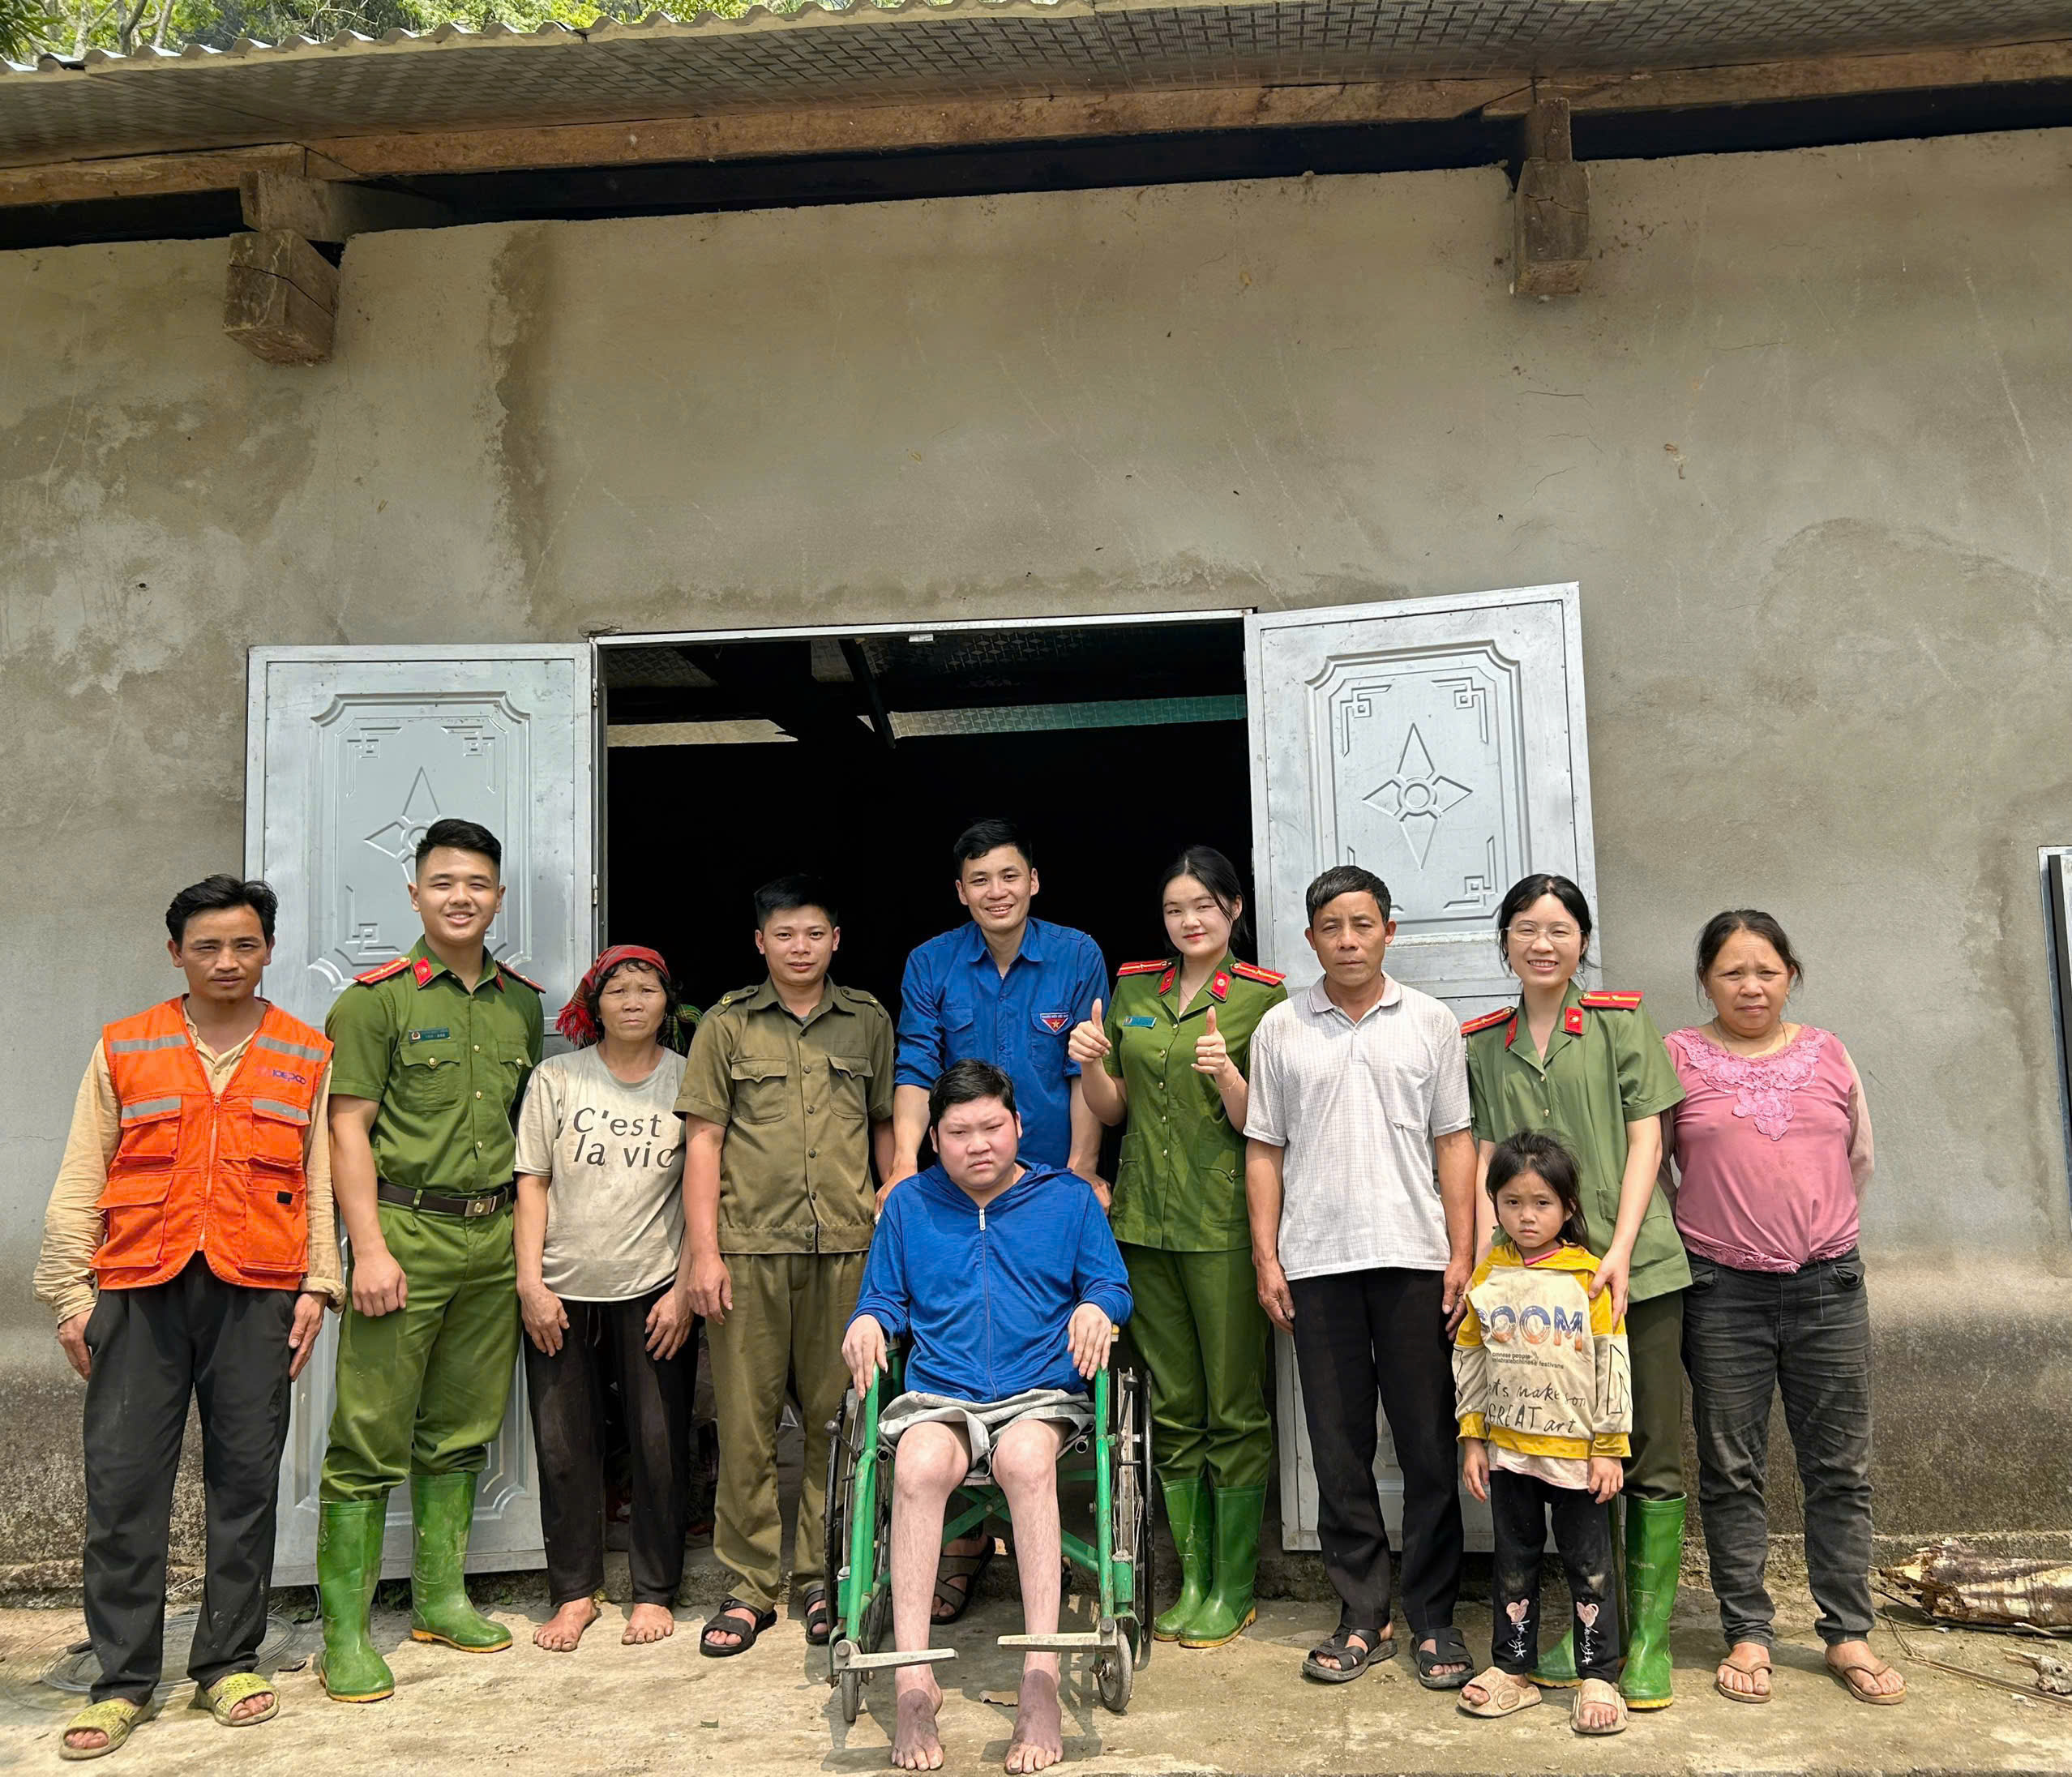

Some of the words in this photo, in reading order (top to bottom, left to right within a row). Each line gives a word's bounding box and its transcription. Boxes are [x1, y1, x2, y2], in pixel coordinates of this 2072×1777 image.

[572, 1107, 661, 1137] C'est
[573, 1133, 606, 1167] la
[1488, 1402, 1543, 1430] GREAT
[1543, 1418, 1576, 1433] art
